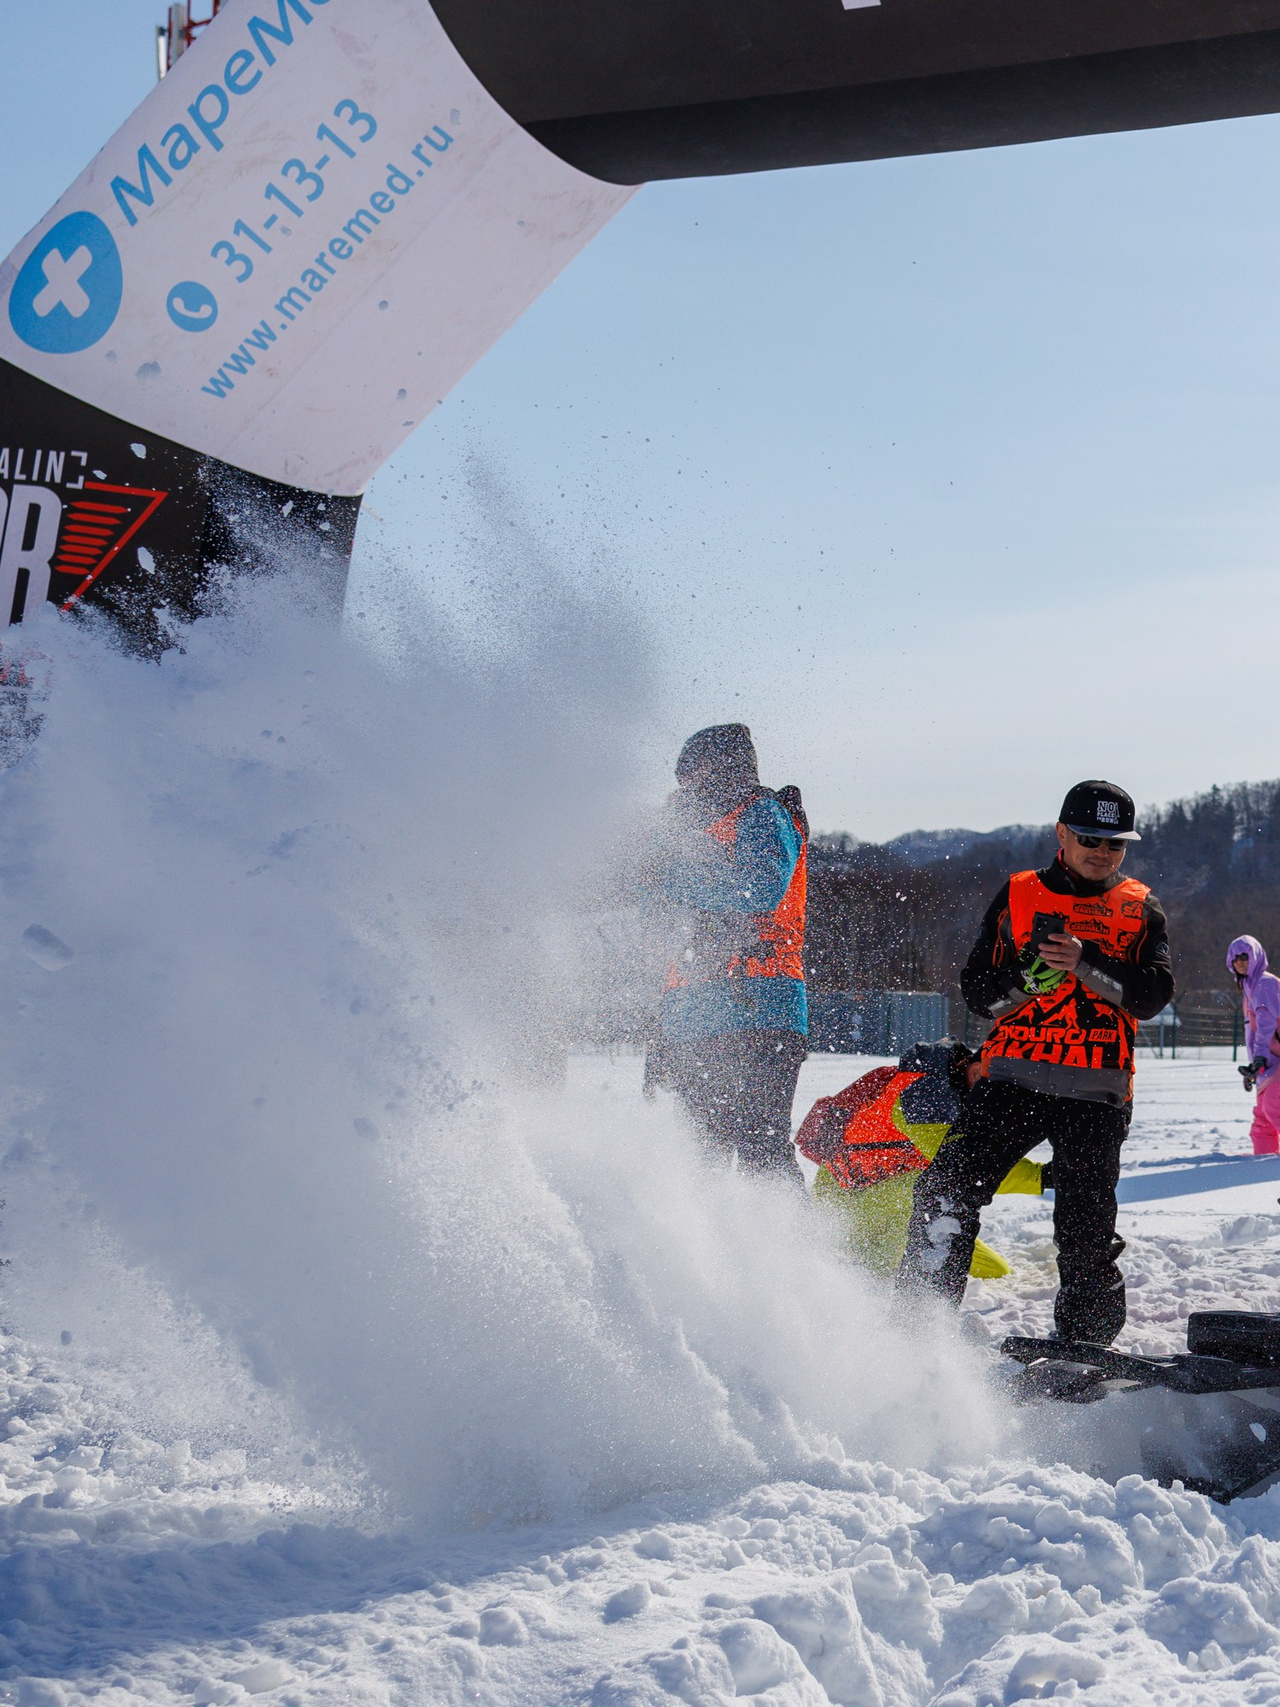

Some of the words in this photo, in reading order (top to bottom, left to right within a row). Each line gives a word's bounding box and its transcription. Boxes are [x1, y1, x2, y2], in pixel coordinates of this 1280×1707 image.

[110, 0, 331, 227] МареМ
[211, 98, 378, 284] 31-13-13
[201, 123, 454, 400] www.maremed.ru
[0, 484, 62, 628] R
[1097, 800, 1115, 812] NO
[993, 1025, 1087, 1044] ENDURO
[1092, 1029, 1115, 1041] PARK
